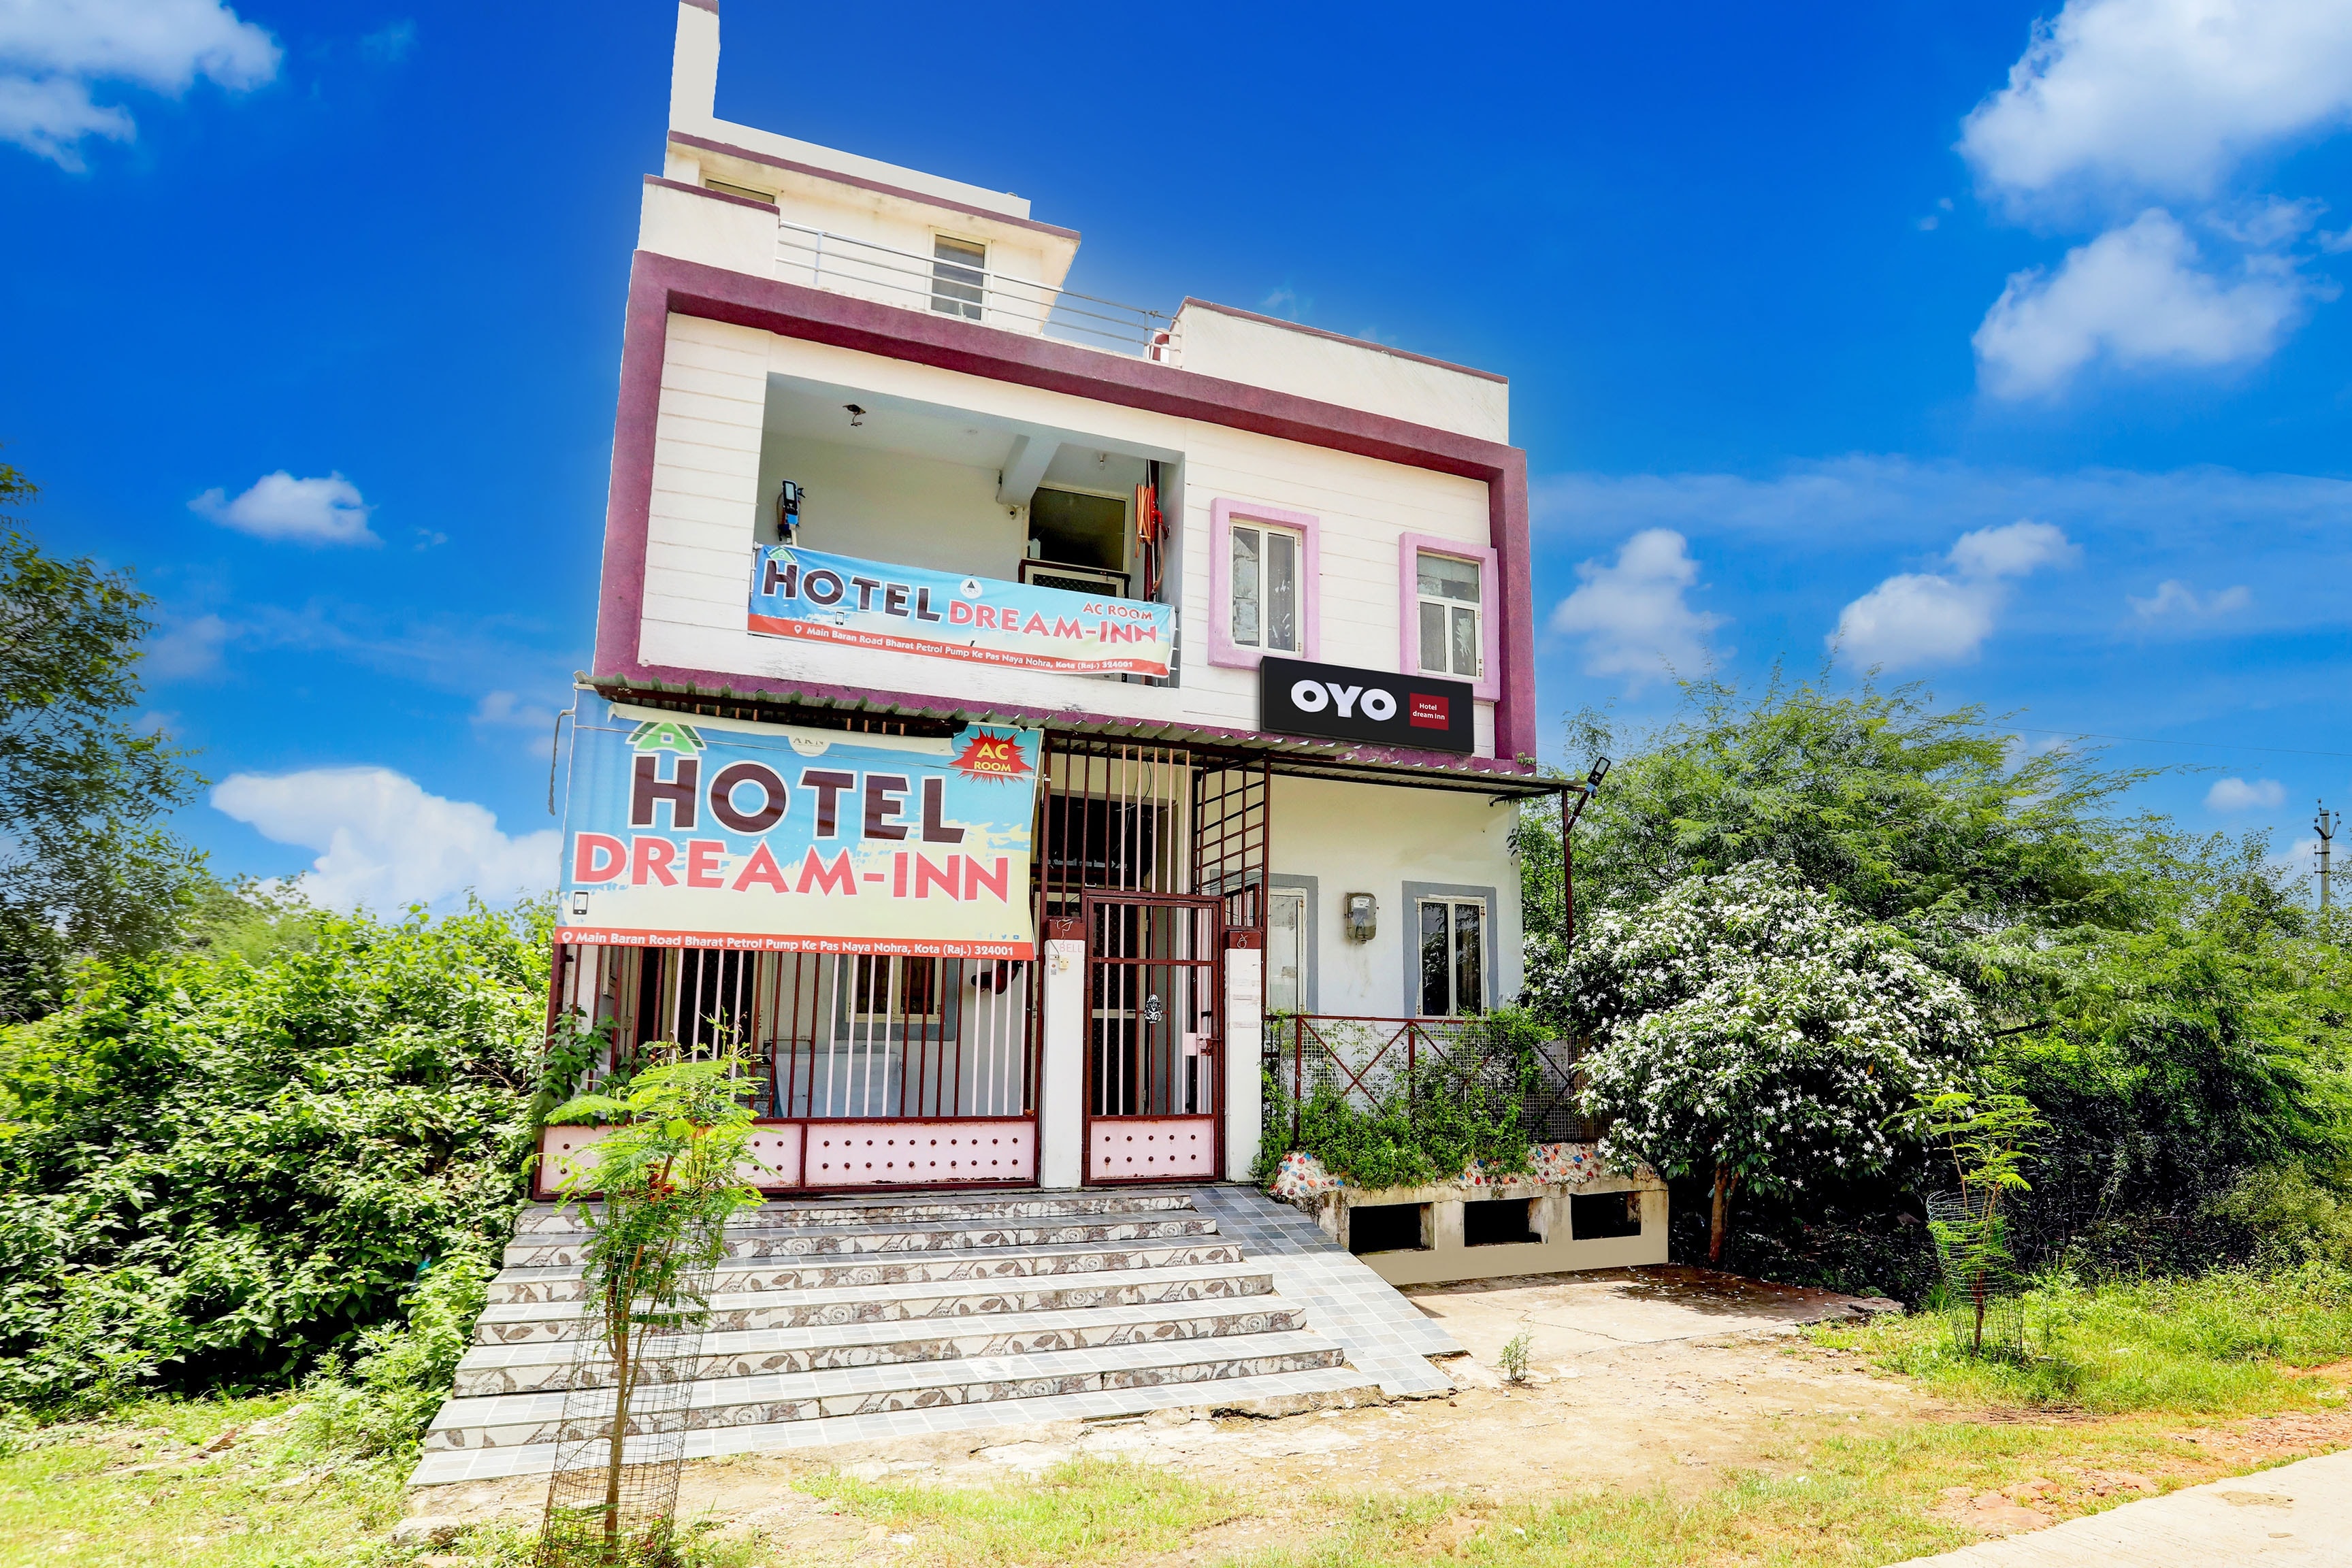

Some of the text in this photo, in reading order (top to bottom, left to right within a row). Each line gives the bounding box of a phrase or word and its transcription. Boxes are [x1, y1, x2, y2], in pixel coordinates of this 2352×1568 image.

[762, 559, 1156, 643] HOTEL DREAM-INN
[1083, 602, 1152, 620] AC ROOM
[806, 627, 829, 637] Main
[832, 630, 857, 642] Baran
[860, 635, 883, 645] Road
[885, 639, 914, 650] Bharat
[916, 643, 943, 653] Petrol
[945, 647, 970, 658] Pump
[972, 650, 983, 659] Ke
[985, 652, 1000, 661] Pas
[1002, 654, 1023, 665] Naya
[1026, 657, 1053, 668] Nohra,
[1290, 679, 1397, 721] OYO
[1419, 702, 1437, 710] Hotel
[1412, 710, 1434, 719] dream
[976, 742, 1009, 760] AC
[974, 761, 1011, 772] ROOM
[630, 755, 965, 843] HOTEL
[574, 834, 1008, 903] DREAM-INN
[576, 931, 1013, 957] Main Baran Road Bharat Petrol Pump Ke Pas Naya Nohra, Kota (Raj.) 324001
[1060, 943, 1082, 953] BELL
